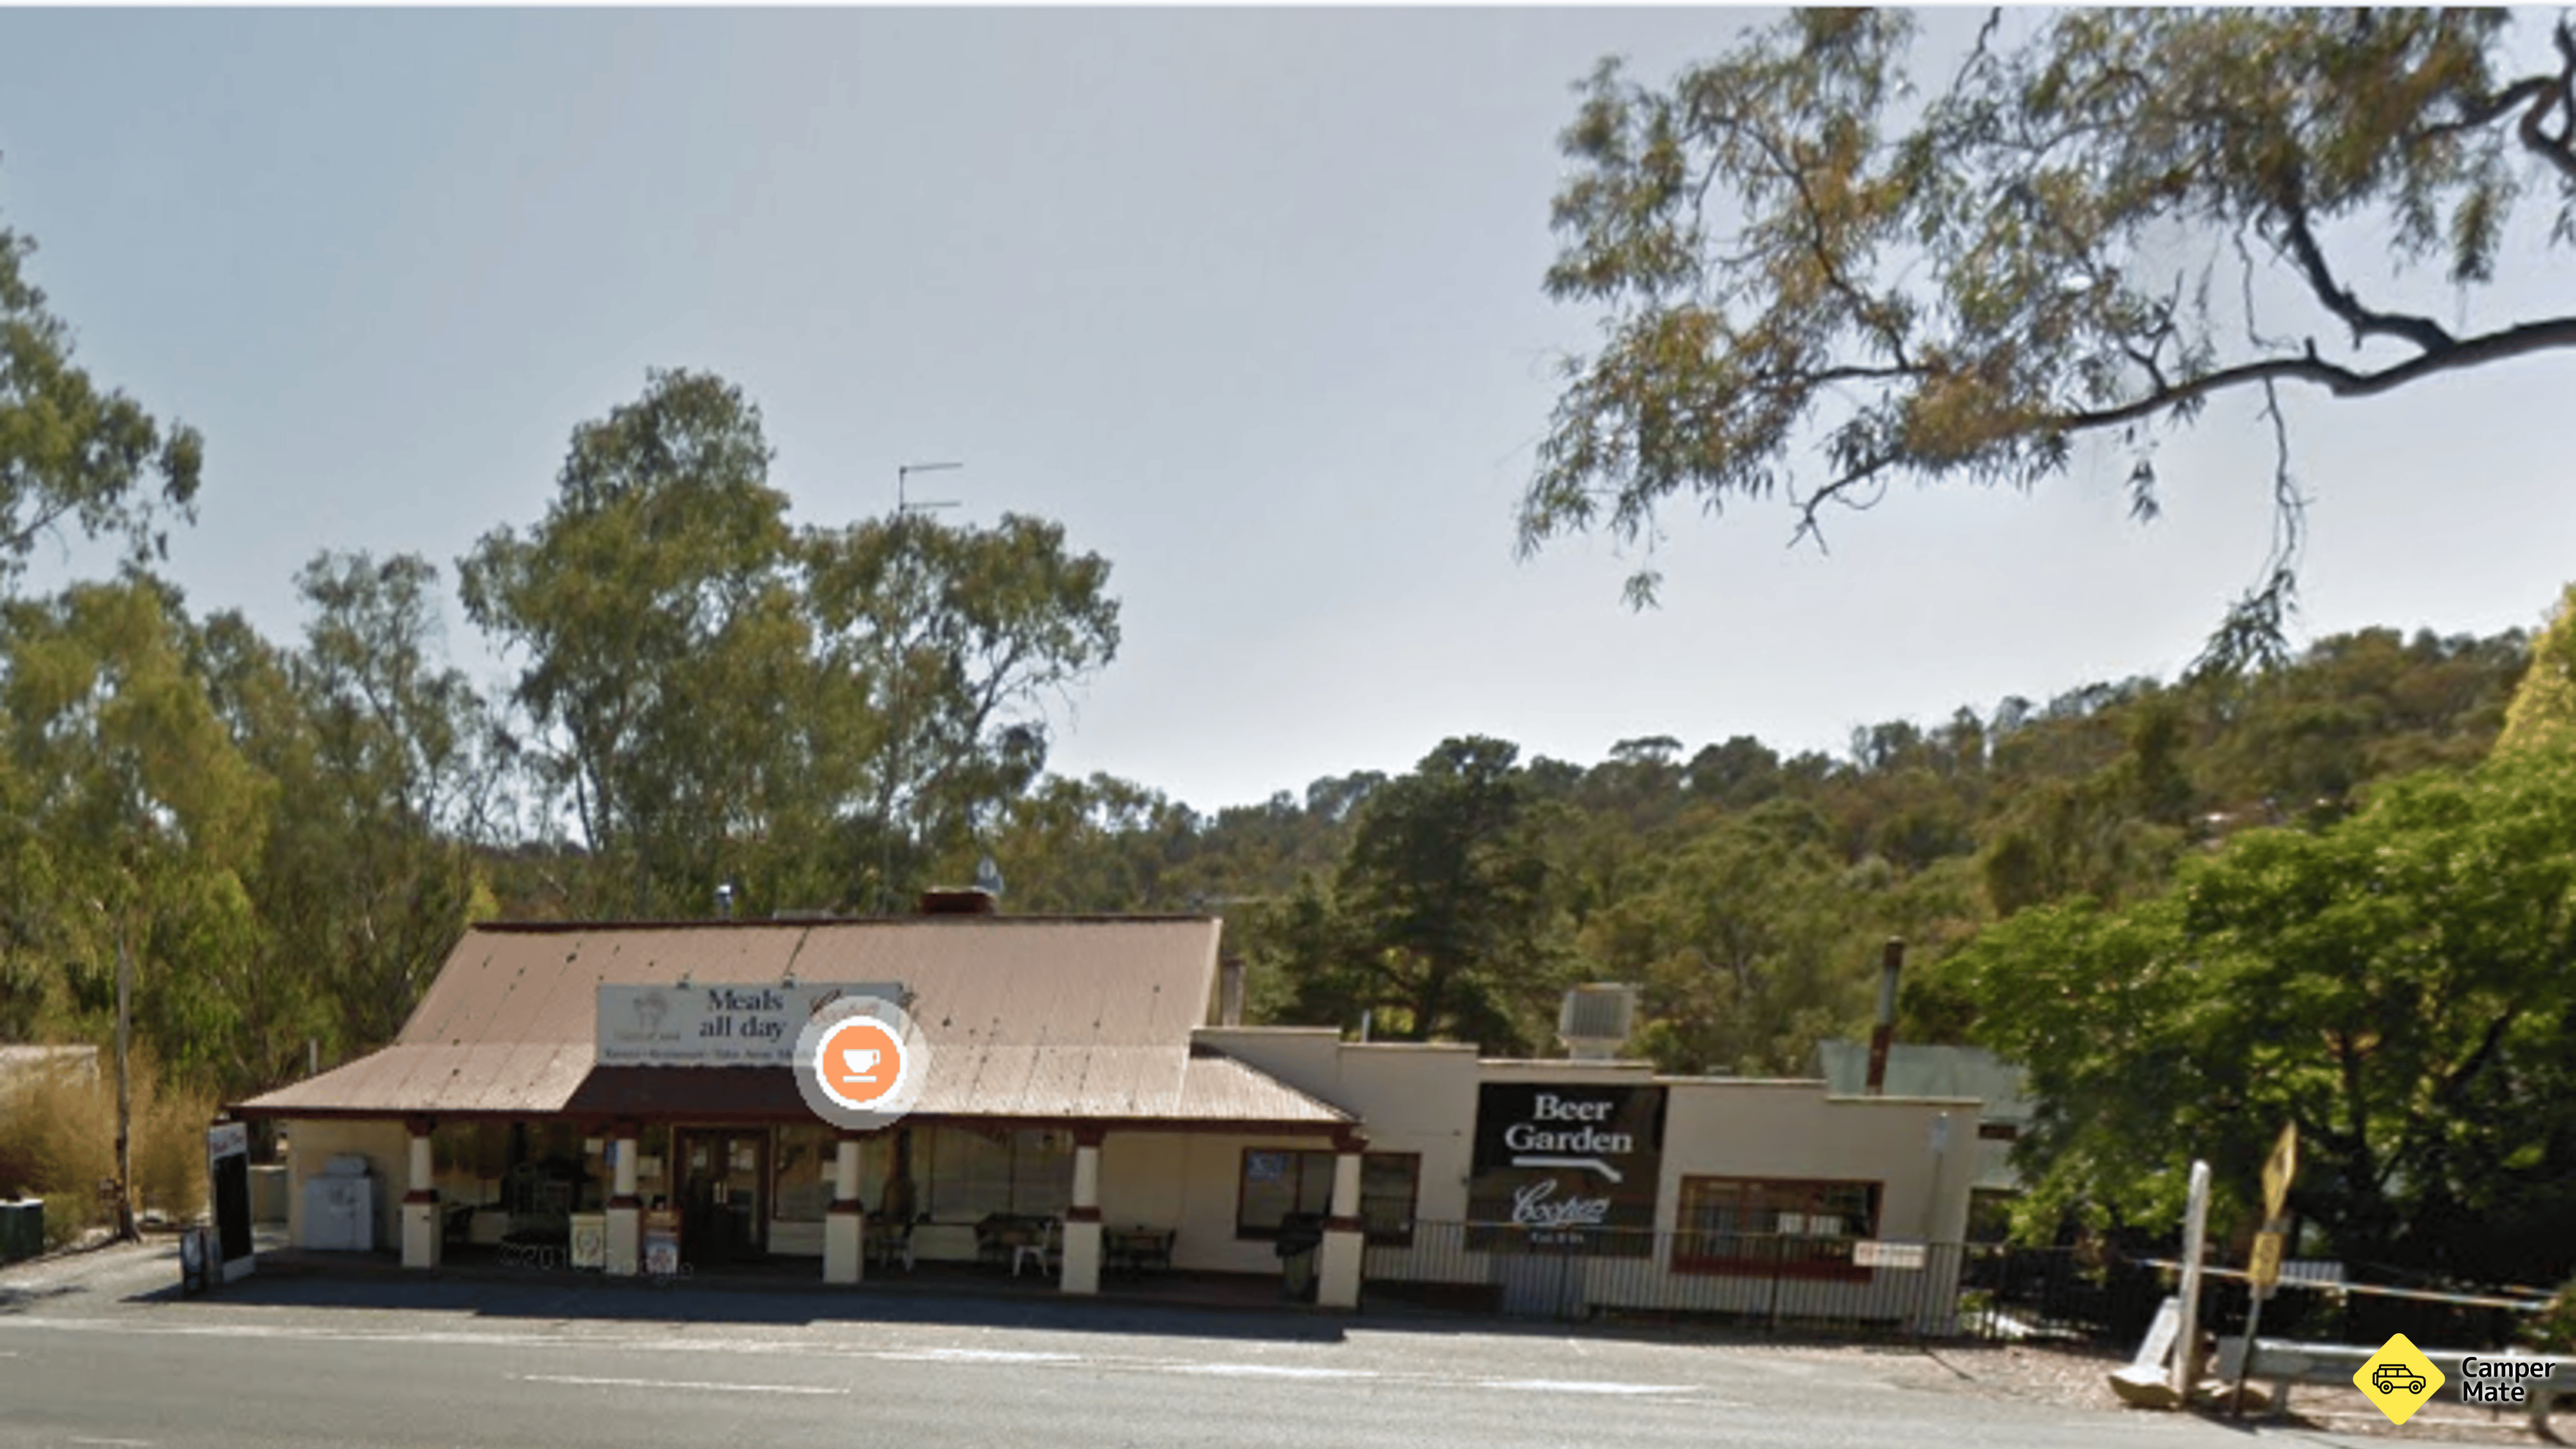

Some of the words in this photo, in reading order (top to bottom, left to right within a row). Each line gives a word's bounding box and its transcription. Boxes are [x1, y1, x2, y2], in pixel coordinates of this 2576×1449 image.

[708, 989, 784, 1012] Meals
[699, 1016, 731, 1037] all
[739, 1016, 787, 1043] day
[1533, 1093, 1614, 1121] Beer
[1504, 1123, 1634, 1153] Garden
